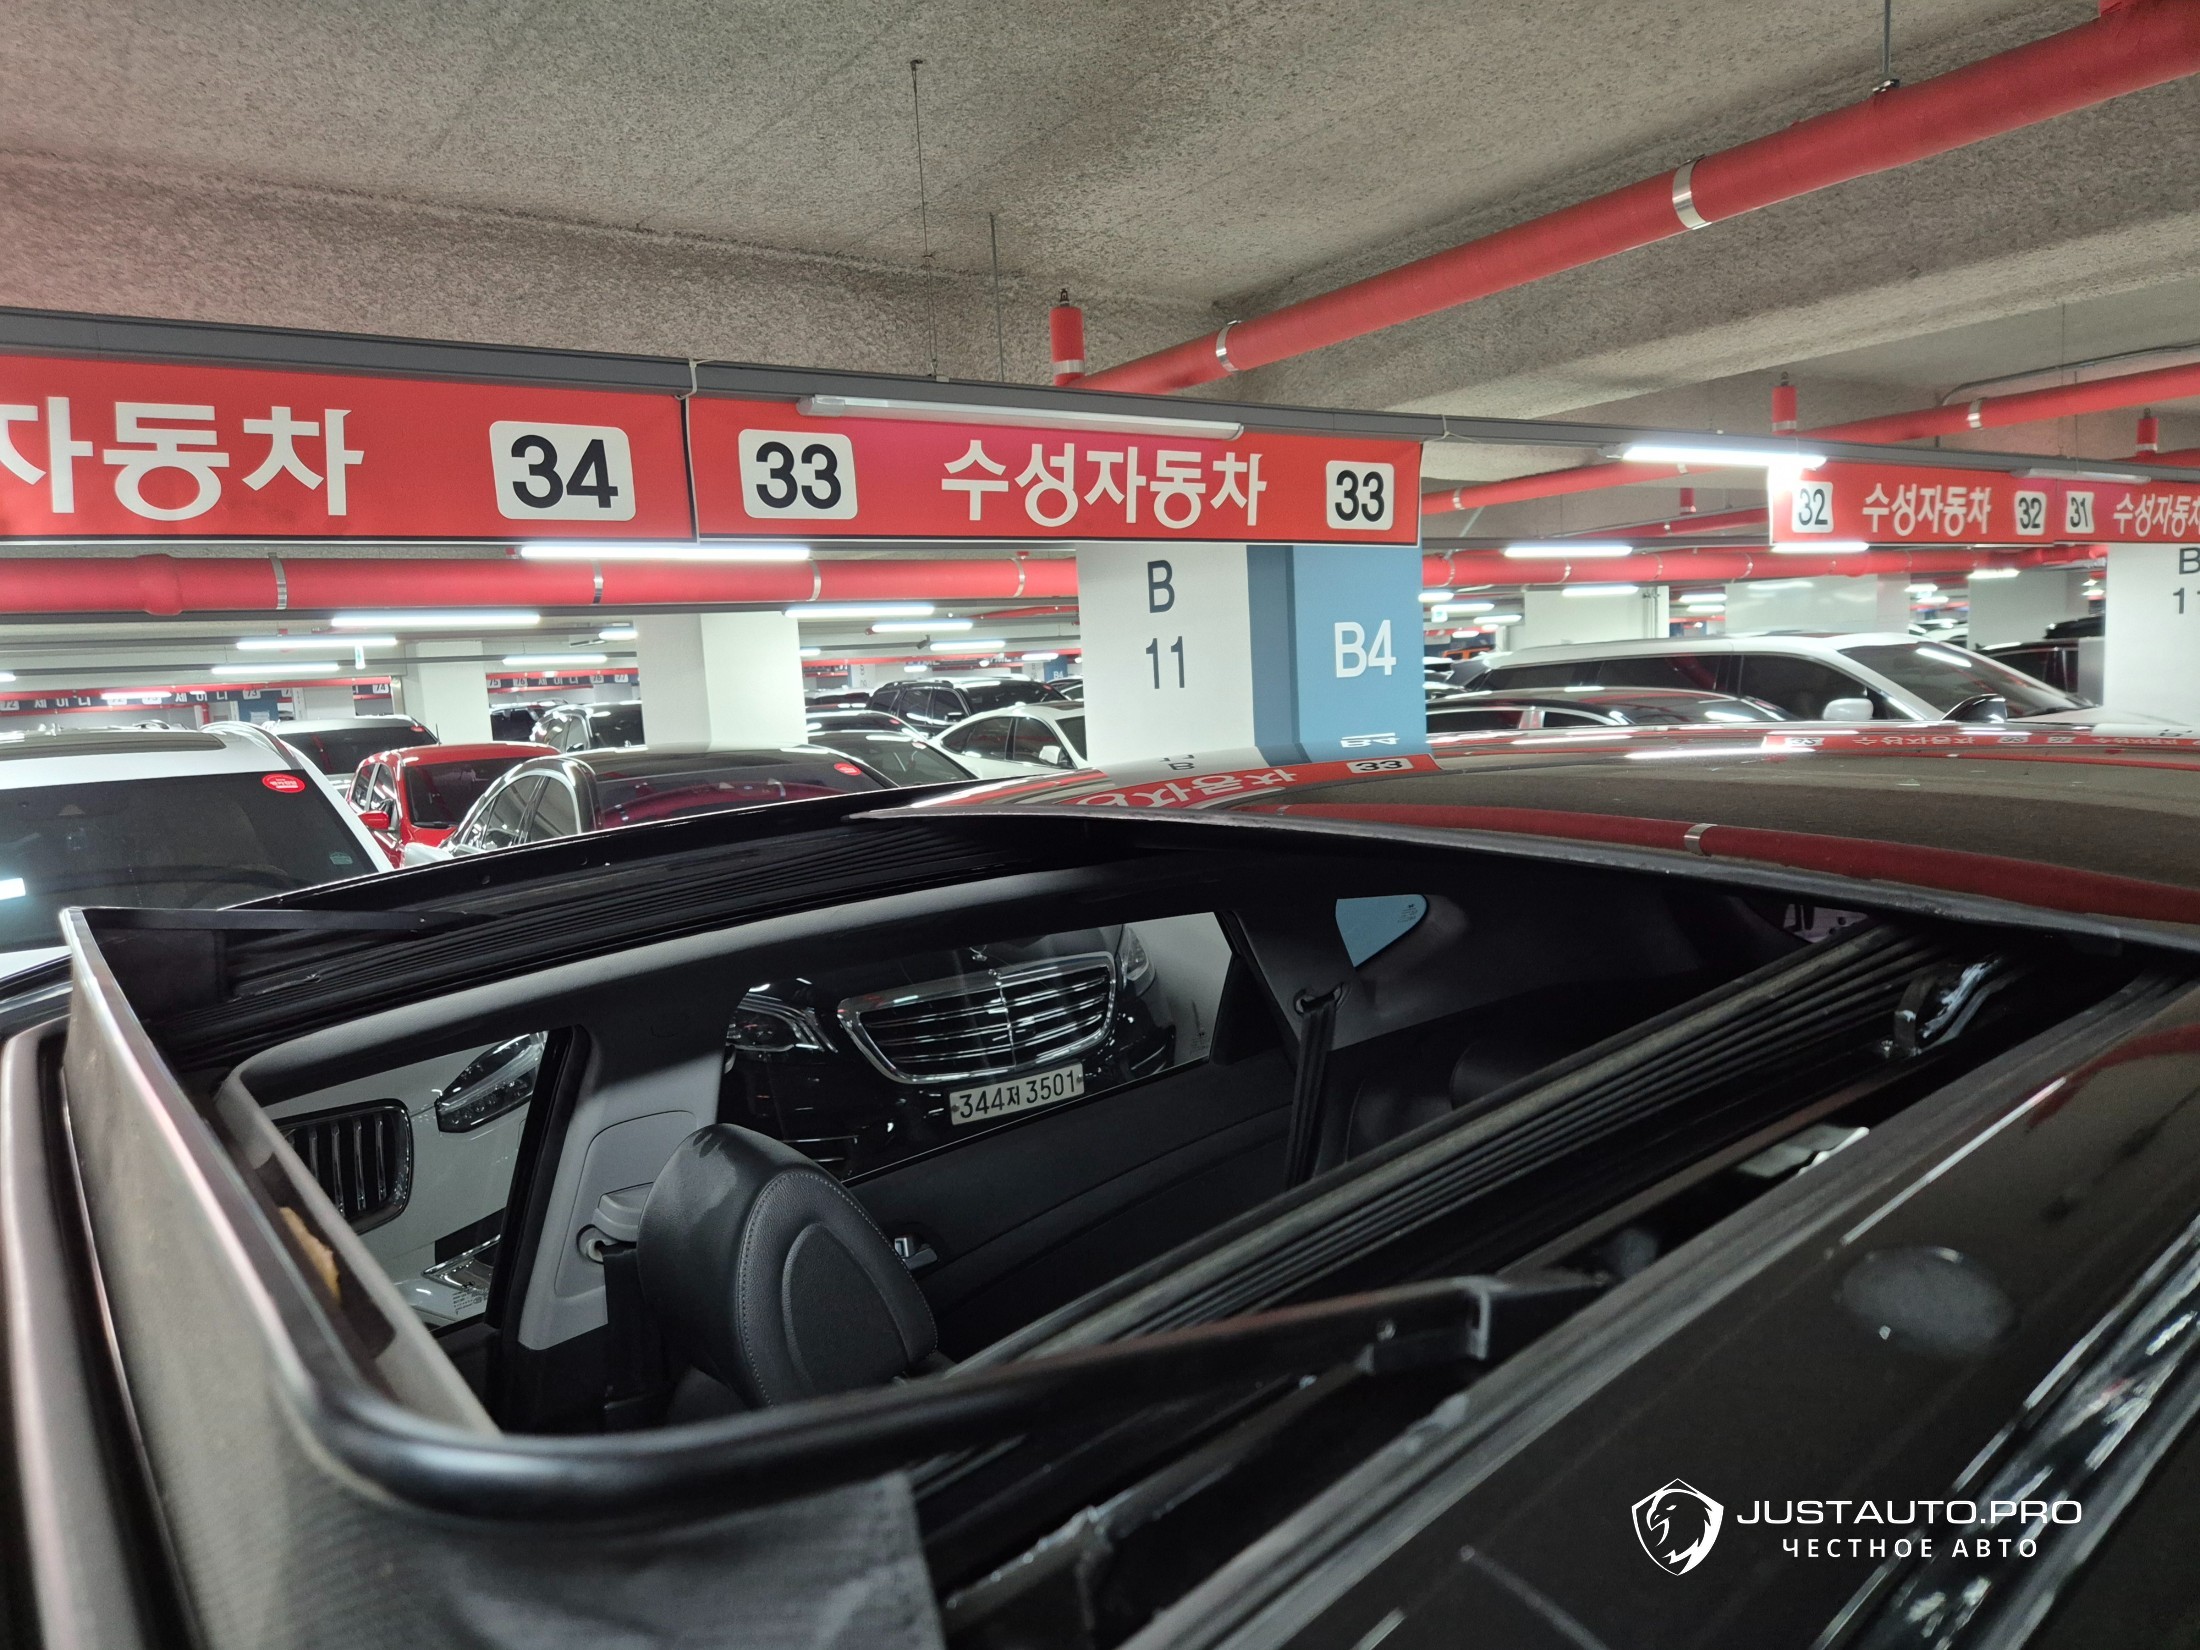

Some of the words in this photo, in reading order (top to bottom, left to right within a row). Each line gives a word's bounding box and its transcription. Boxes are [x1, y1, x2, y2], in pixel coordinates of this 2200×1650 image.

[0, 396, 365, 522] 자동차
[510, 433, 619, 509] 34
[754, 441, 843, 511] 33
[940, 438, 1268, 530] 수성자동차
[1334, 469, 1387, 523] 33
[1799, 488, 1828, 526] 32
[1861, 482, 1992, 537] 수성자동차
[2018, 498, 2042, 530] 32
[2069, 497, 2091, 528] 31
[1148, 559, 1176, 614] B
[2178, 547, 2200, 575] B
[2172, 587, 2200, 615] 1
[1144, 635, 1186, 690] 11
[1333, 618, 1398, 679] B4
[959, 1085, 1020, 1119] 344저
[1026, 1069, 1075, 1104] 3501
